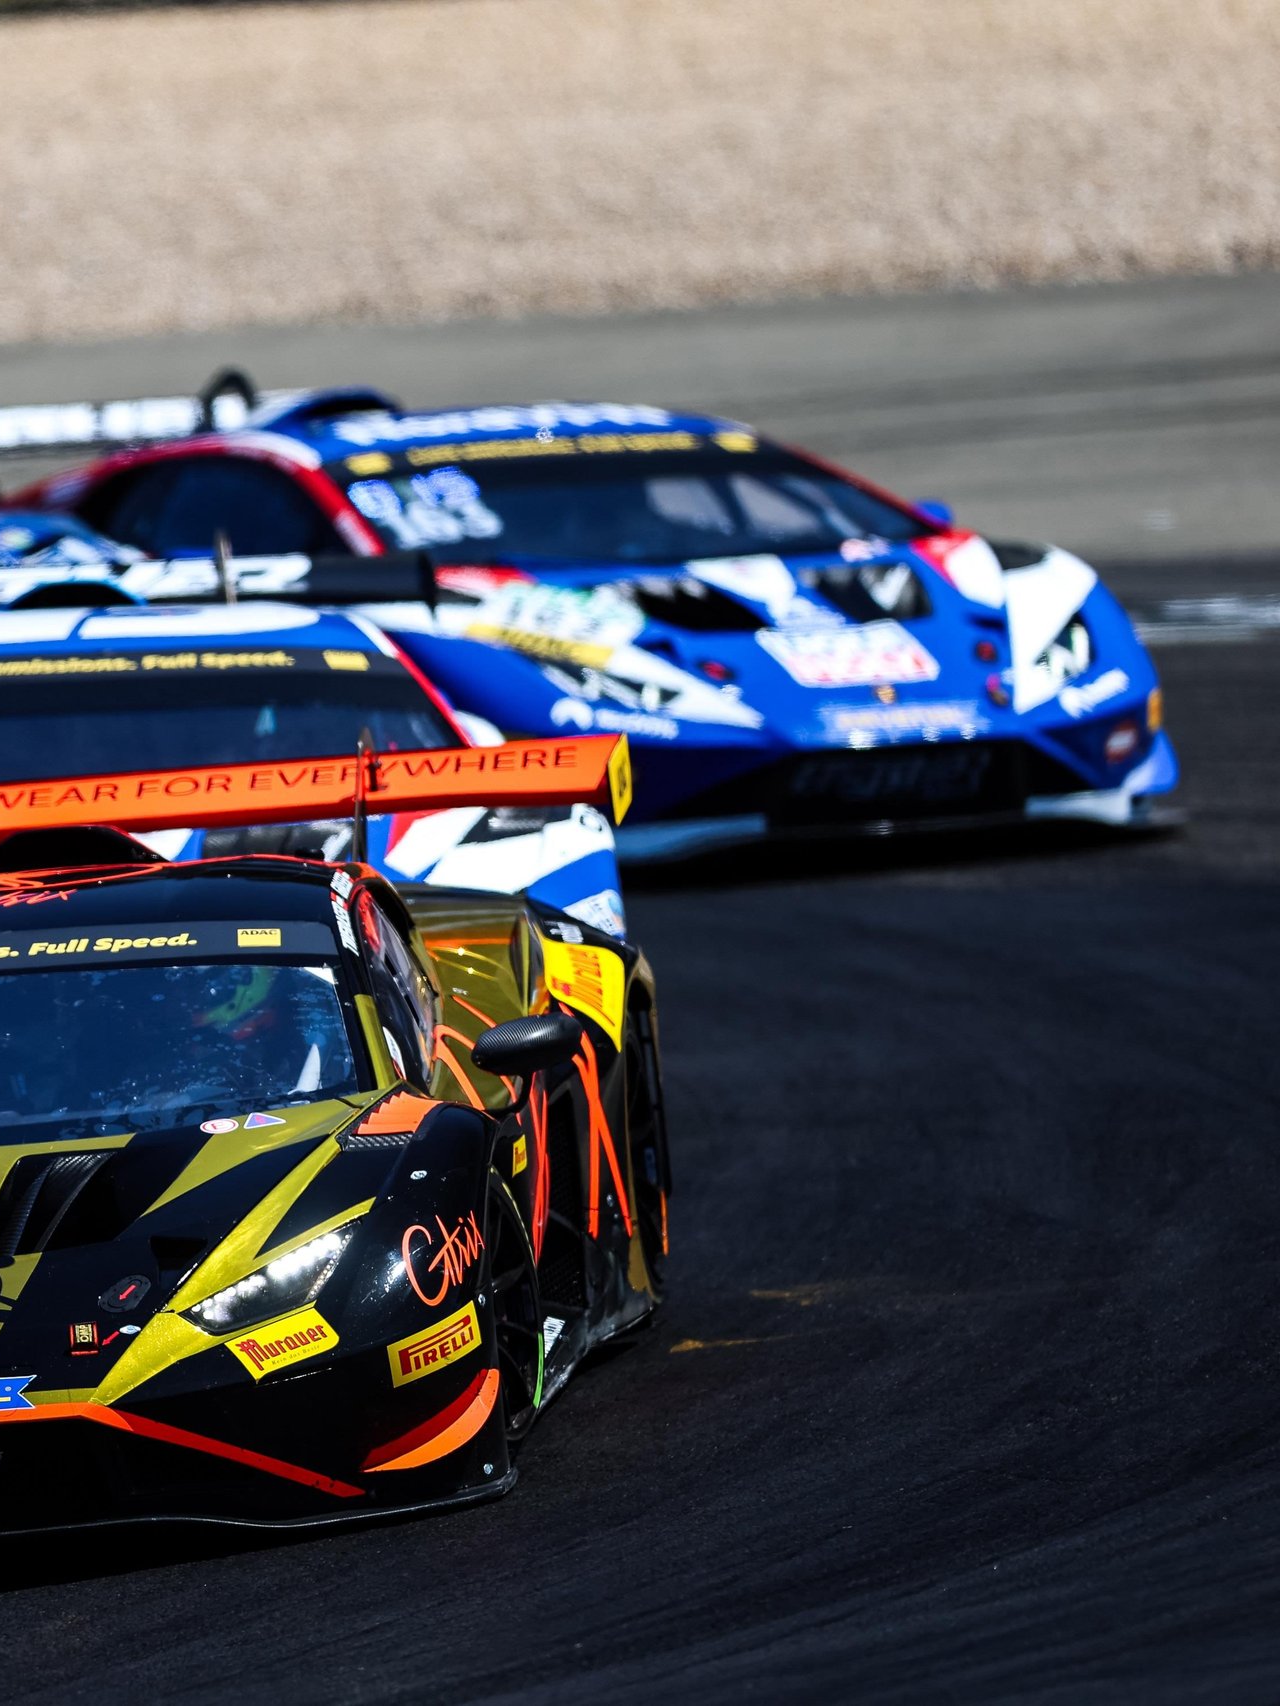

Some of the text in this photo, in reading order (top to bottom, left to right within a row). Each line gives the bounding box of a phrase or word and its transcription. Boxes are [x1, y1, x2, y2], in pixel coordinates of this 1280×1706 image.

[136, 775, 232, 800] FOR
[28, 938, 90, 956] Full
[93, 933, 198, 953] Speed.
[235, 1324, 328, 1371] Murauer
[398, 1314, 475, 1376] PIRELLI
